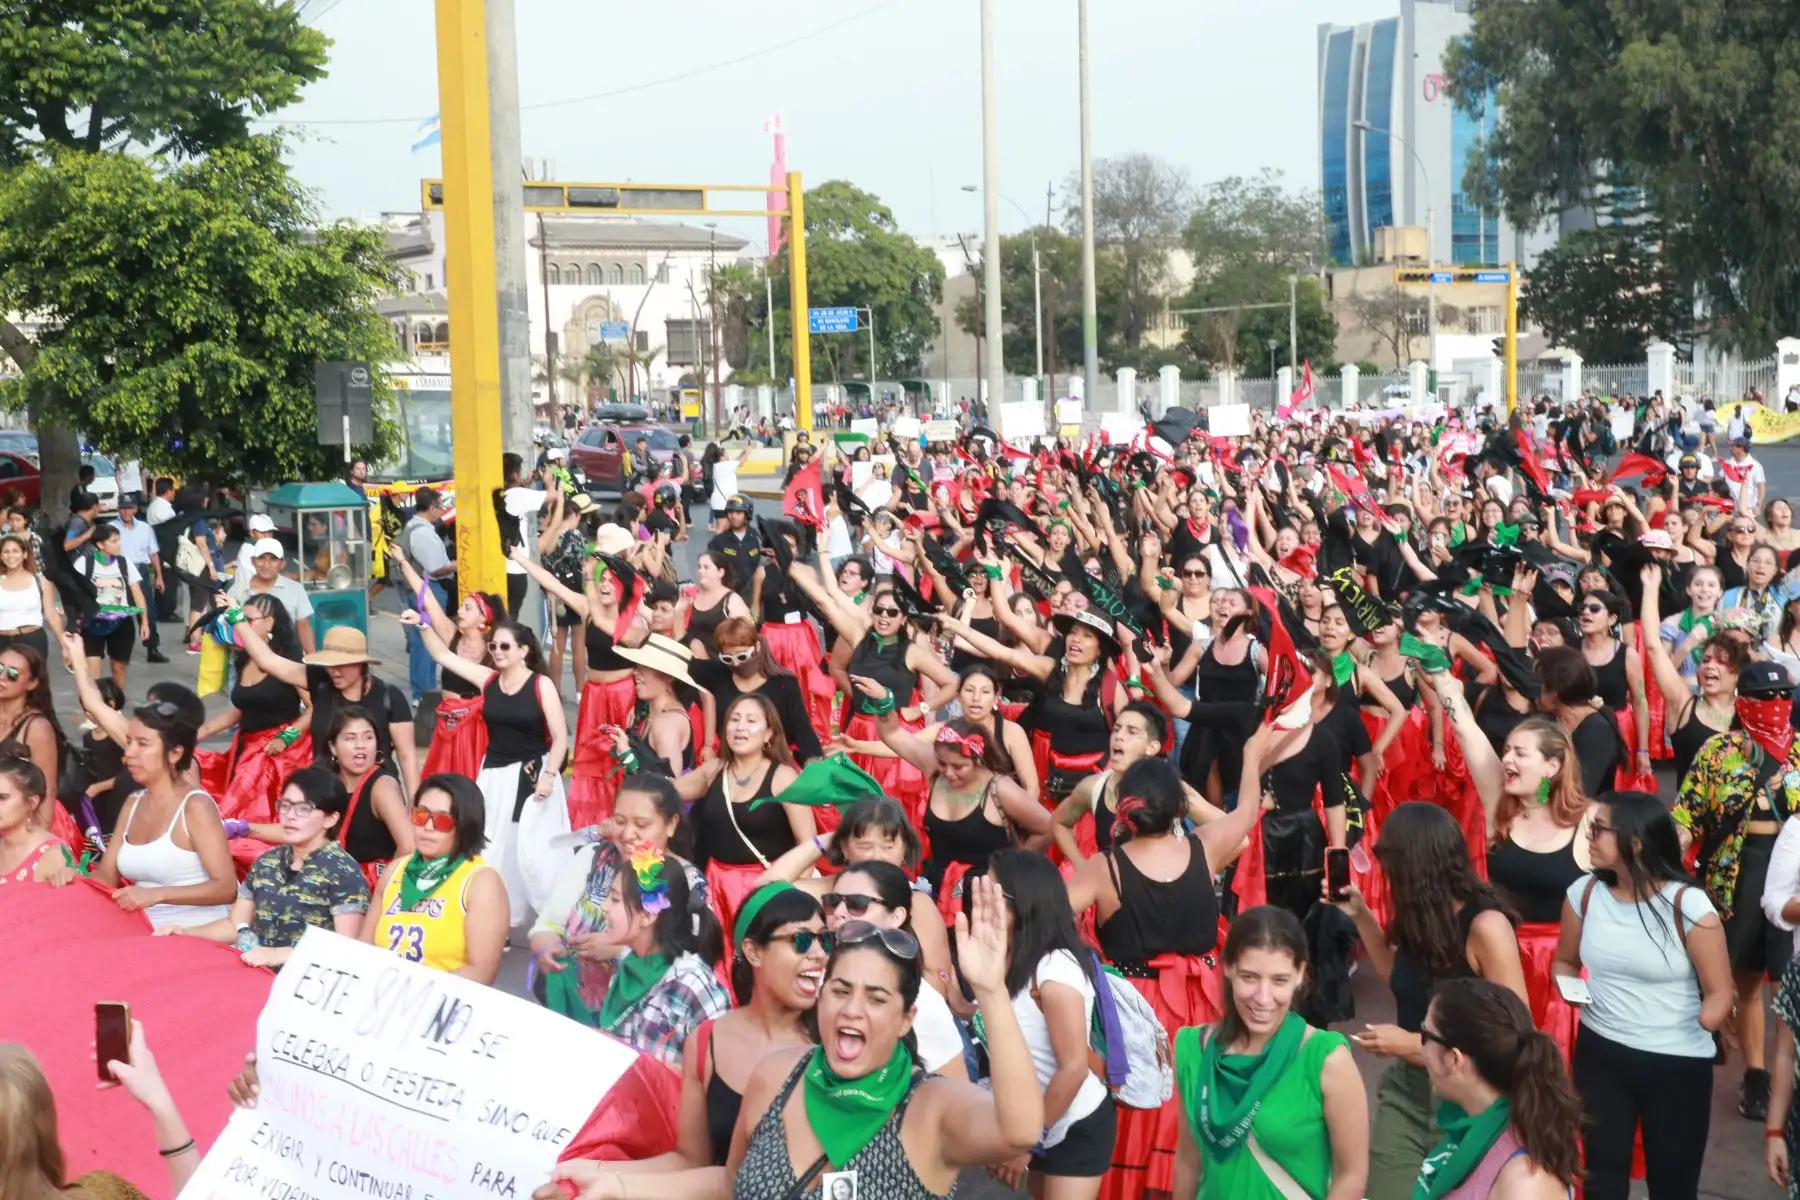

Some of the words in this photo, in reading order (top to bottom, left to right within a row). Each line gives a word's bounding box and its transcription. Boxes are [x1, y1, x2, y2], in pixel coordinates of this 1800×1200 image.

[389, 925, 423, 963] 23
[293, 962, 360, 1015] ESTE
[355, 967, 436, 1046] 8M
[421, 994, 473, 1046] NO
[472, 1031, 510, 1060] SE
[271, 1030, 351, 1081] CELEBRA
[361, 1062, 374, 1083] O
[382, 1067, 466, 1113] FESTEJA
[477, 1099, 530, 1134] SINO
[532, 1120, 572, 1145] QUE
[223, 1156, 260, 1188] POR
[251, 1121, 304, 1169] EXIGIR
[314, 1151, 324, 1179] Y
[327, 1160, 414, 1200] CONTINUAR
[329, 1103, 346, 1142] A
[349, 1106, 388, 1157] LAS
[387, 1125, 460, 1184] CALLES
[470, 1162, 517, 1199] PARA
